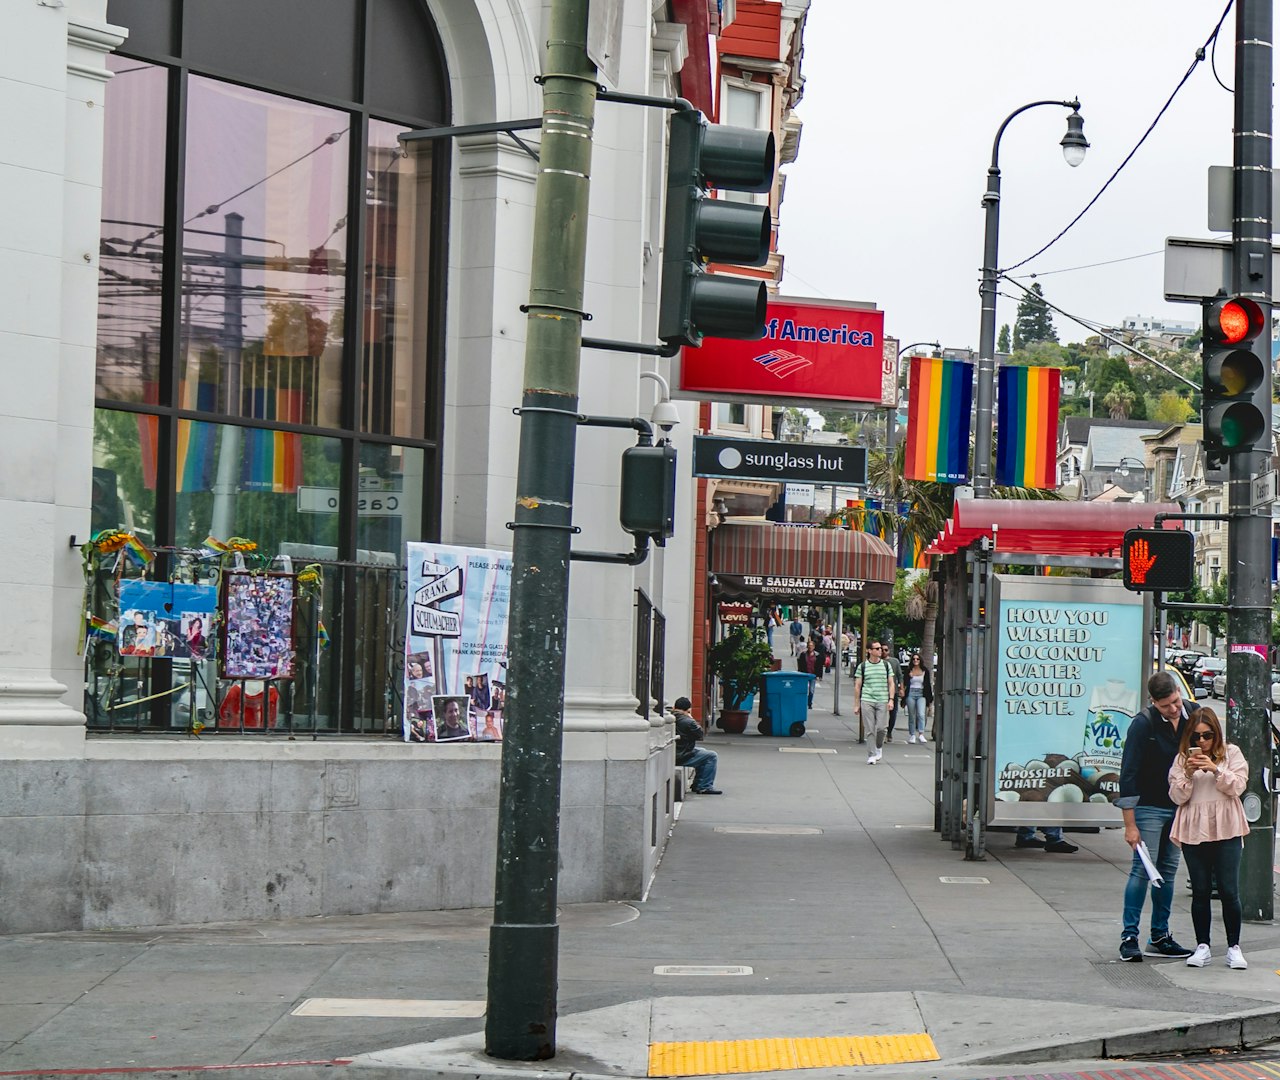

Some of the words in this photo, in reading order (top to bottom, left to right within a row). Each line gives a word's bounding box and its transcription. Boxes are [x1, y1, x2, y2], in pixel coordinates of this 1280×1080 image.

[781, 319, 875, 347] America
[745, 452, 814, 471] sunglass
[817, 454, 844, 471] hut
[469, 562, 489, 570] PLEASE
[420, 580, 449, 603] FRANK
[743, 576, 763, 586] THE
[767, 577, 816, 588] SAUSAGE
[819, 579, 866, 591] FACTORY
[761, 586, 807, 595] RESTAURANT
[814, 589, 845, 597] PIZZERIA
[416, 610, 458, 632] SCHUMACHER
[1007, 608, 1061, 624] HOW
[1064, 610, 1109, 626] YOU
[1007, 626, 1091, 643] WISHED
[1006, 644, 1106, 662] COCONUT
[1006, 663, 1081, 680] WATER
[1005, 681, 1086, 697] WOULD
[1005, 699, 1075, 716] TASTE.
[1090, 722, 1120, 740] VITA
[1084, 758, 1105, 766] pressed
[998, 767, 1072, 779] IMPOSSIBLE
[999, 779, 1014, 789] TO
[1014, 779, 1047, 789] HATE
